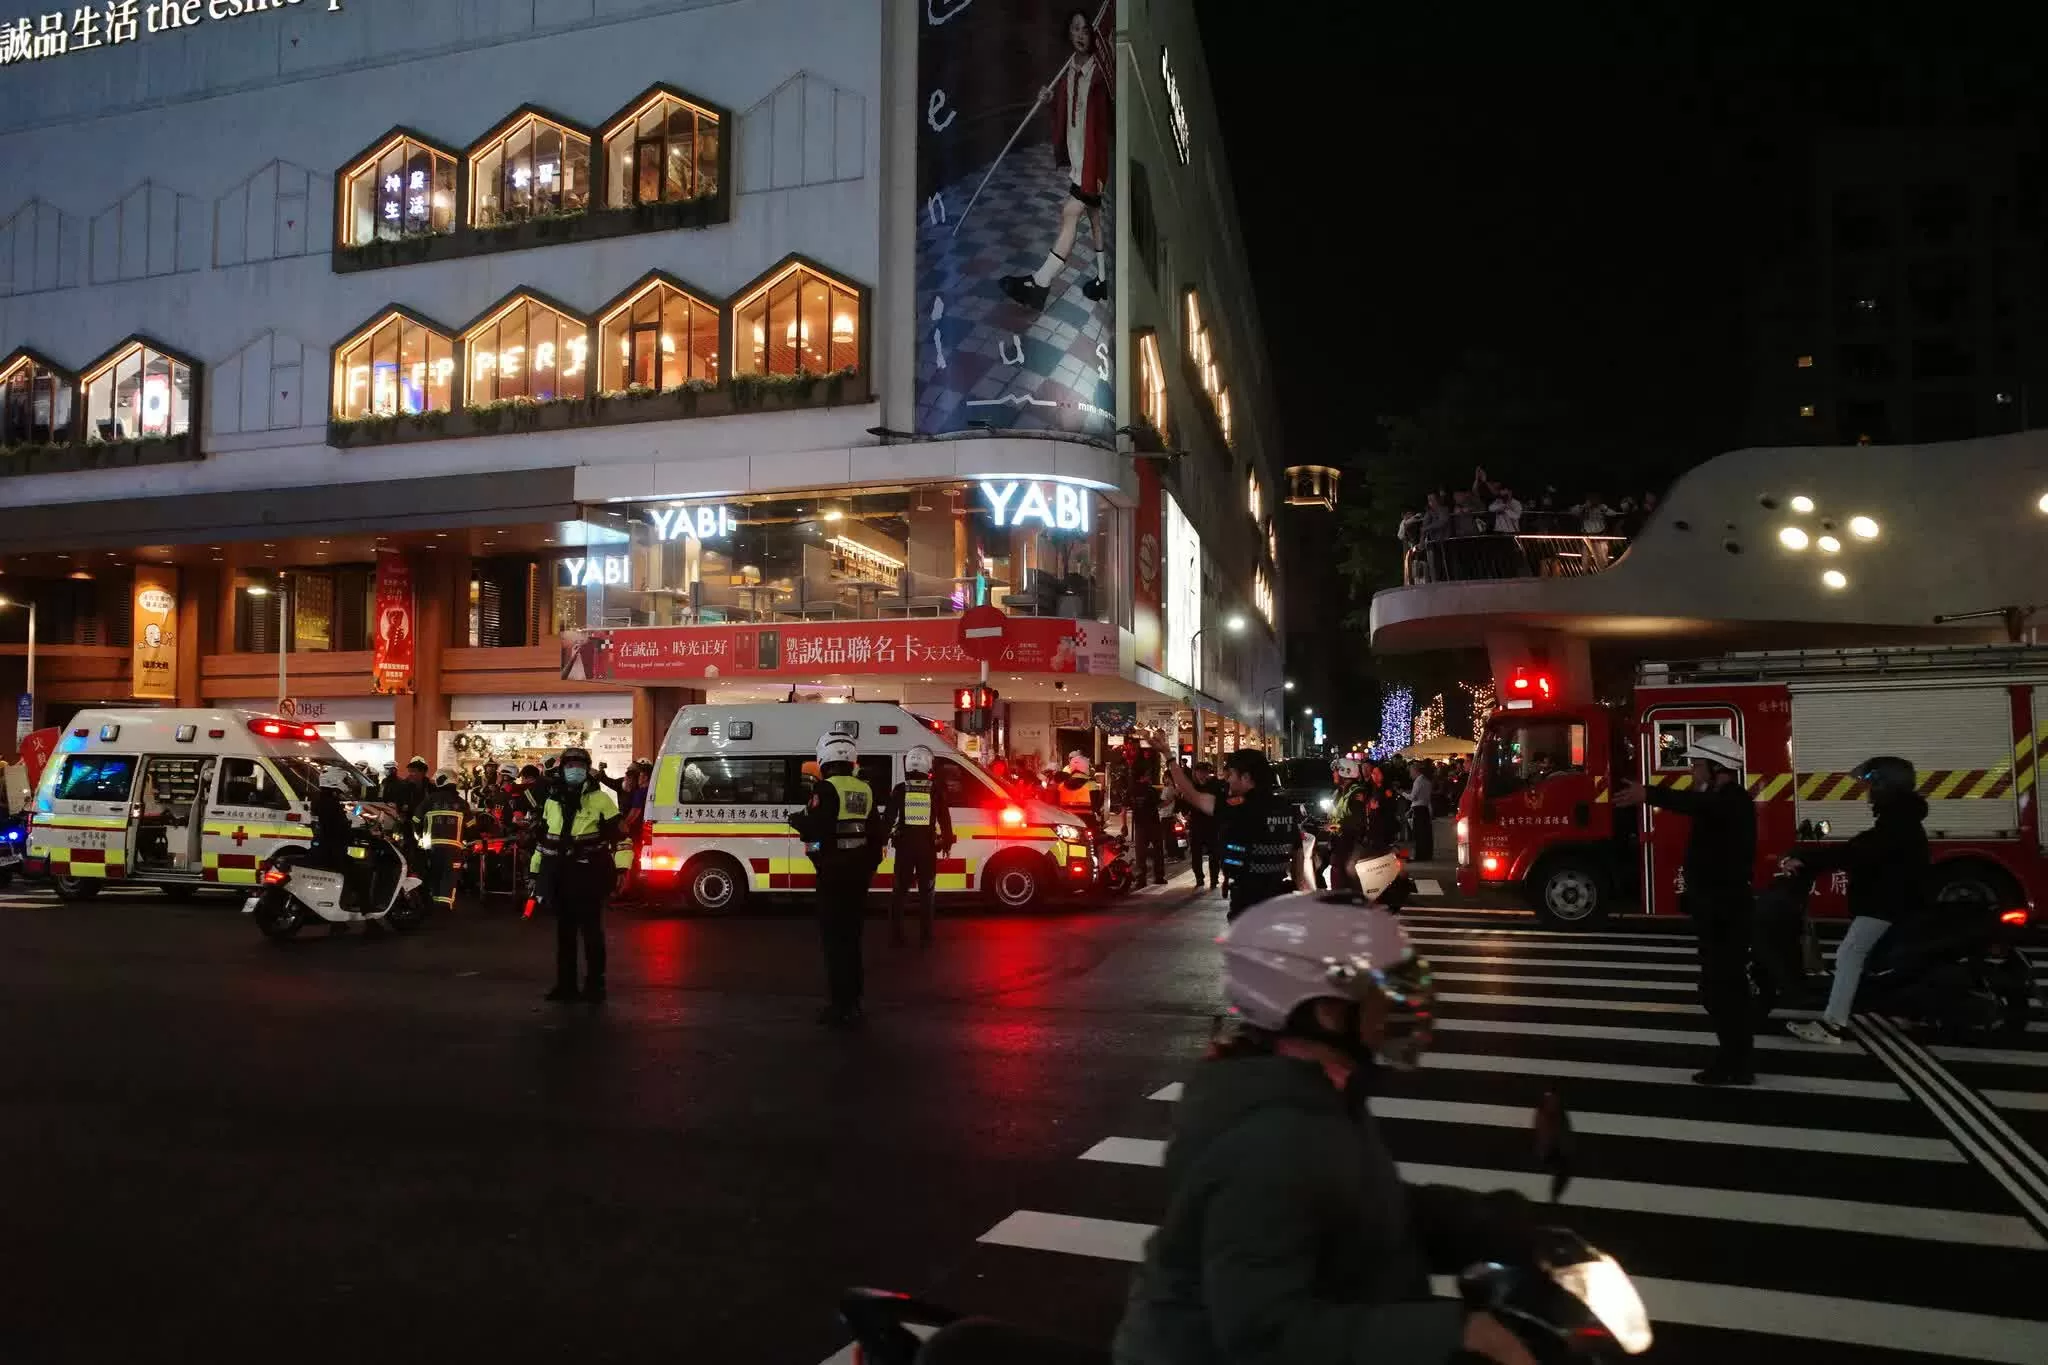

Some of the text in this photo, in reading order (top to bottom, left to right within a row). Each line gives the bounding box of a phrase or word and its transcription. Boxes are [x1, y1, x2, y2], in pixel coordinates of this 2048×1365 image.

[0, 0, 137, 63] 誠品生活
[147, 0, 201, 32] the
[651, 505, 727, 541] YABI
[980, 481, 1089, 533] YABI
[564, 555, 629, 586] YABI
[799, 634, 922, 664] 誠品聯名卡
[1266, 815, 1293, 825] POLICE
